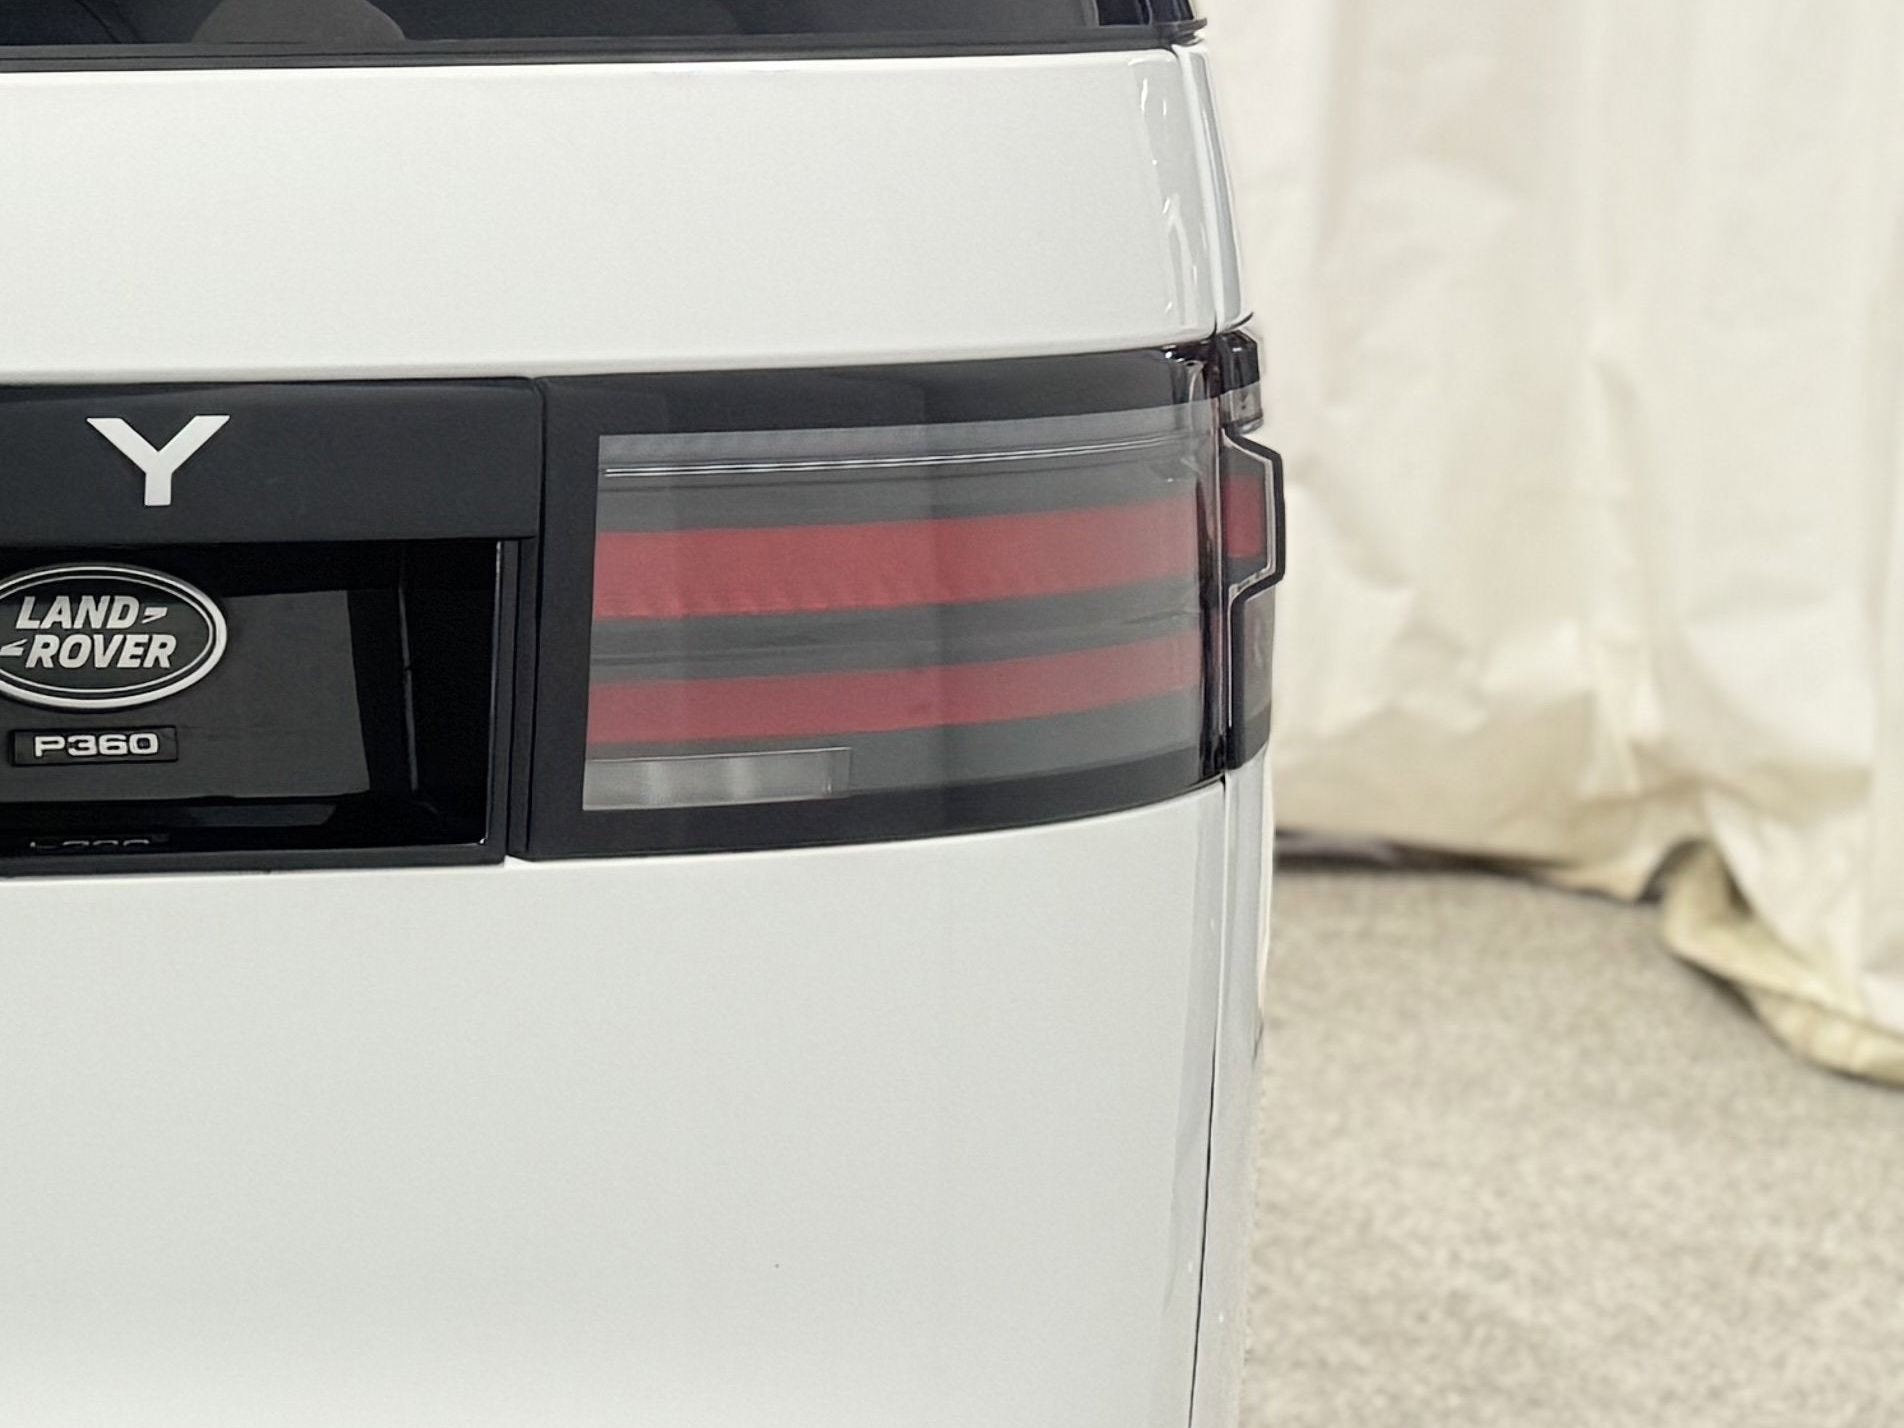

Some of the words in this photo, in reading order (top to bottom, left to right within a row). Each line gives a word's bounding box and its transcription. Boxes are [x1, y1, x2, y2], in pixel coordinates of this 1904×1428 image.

[15, 595, 139, 630] LAND
[25, 633, 177, 669] ROVER
[34, 733, 159, 758] P360
